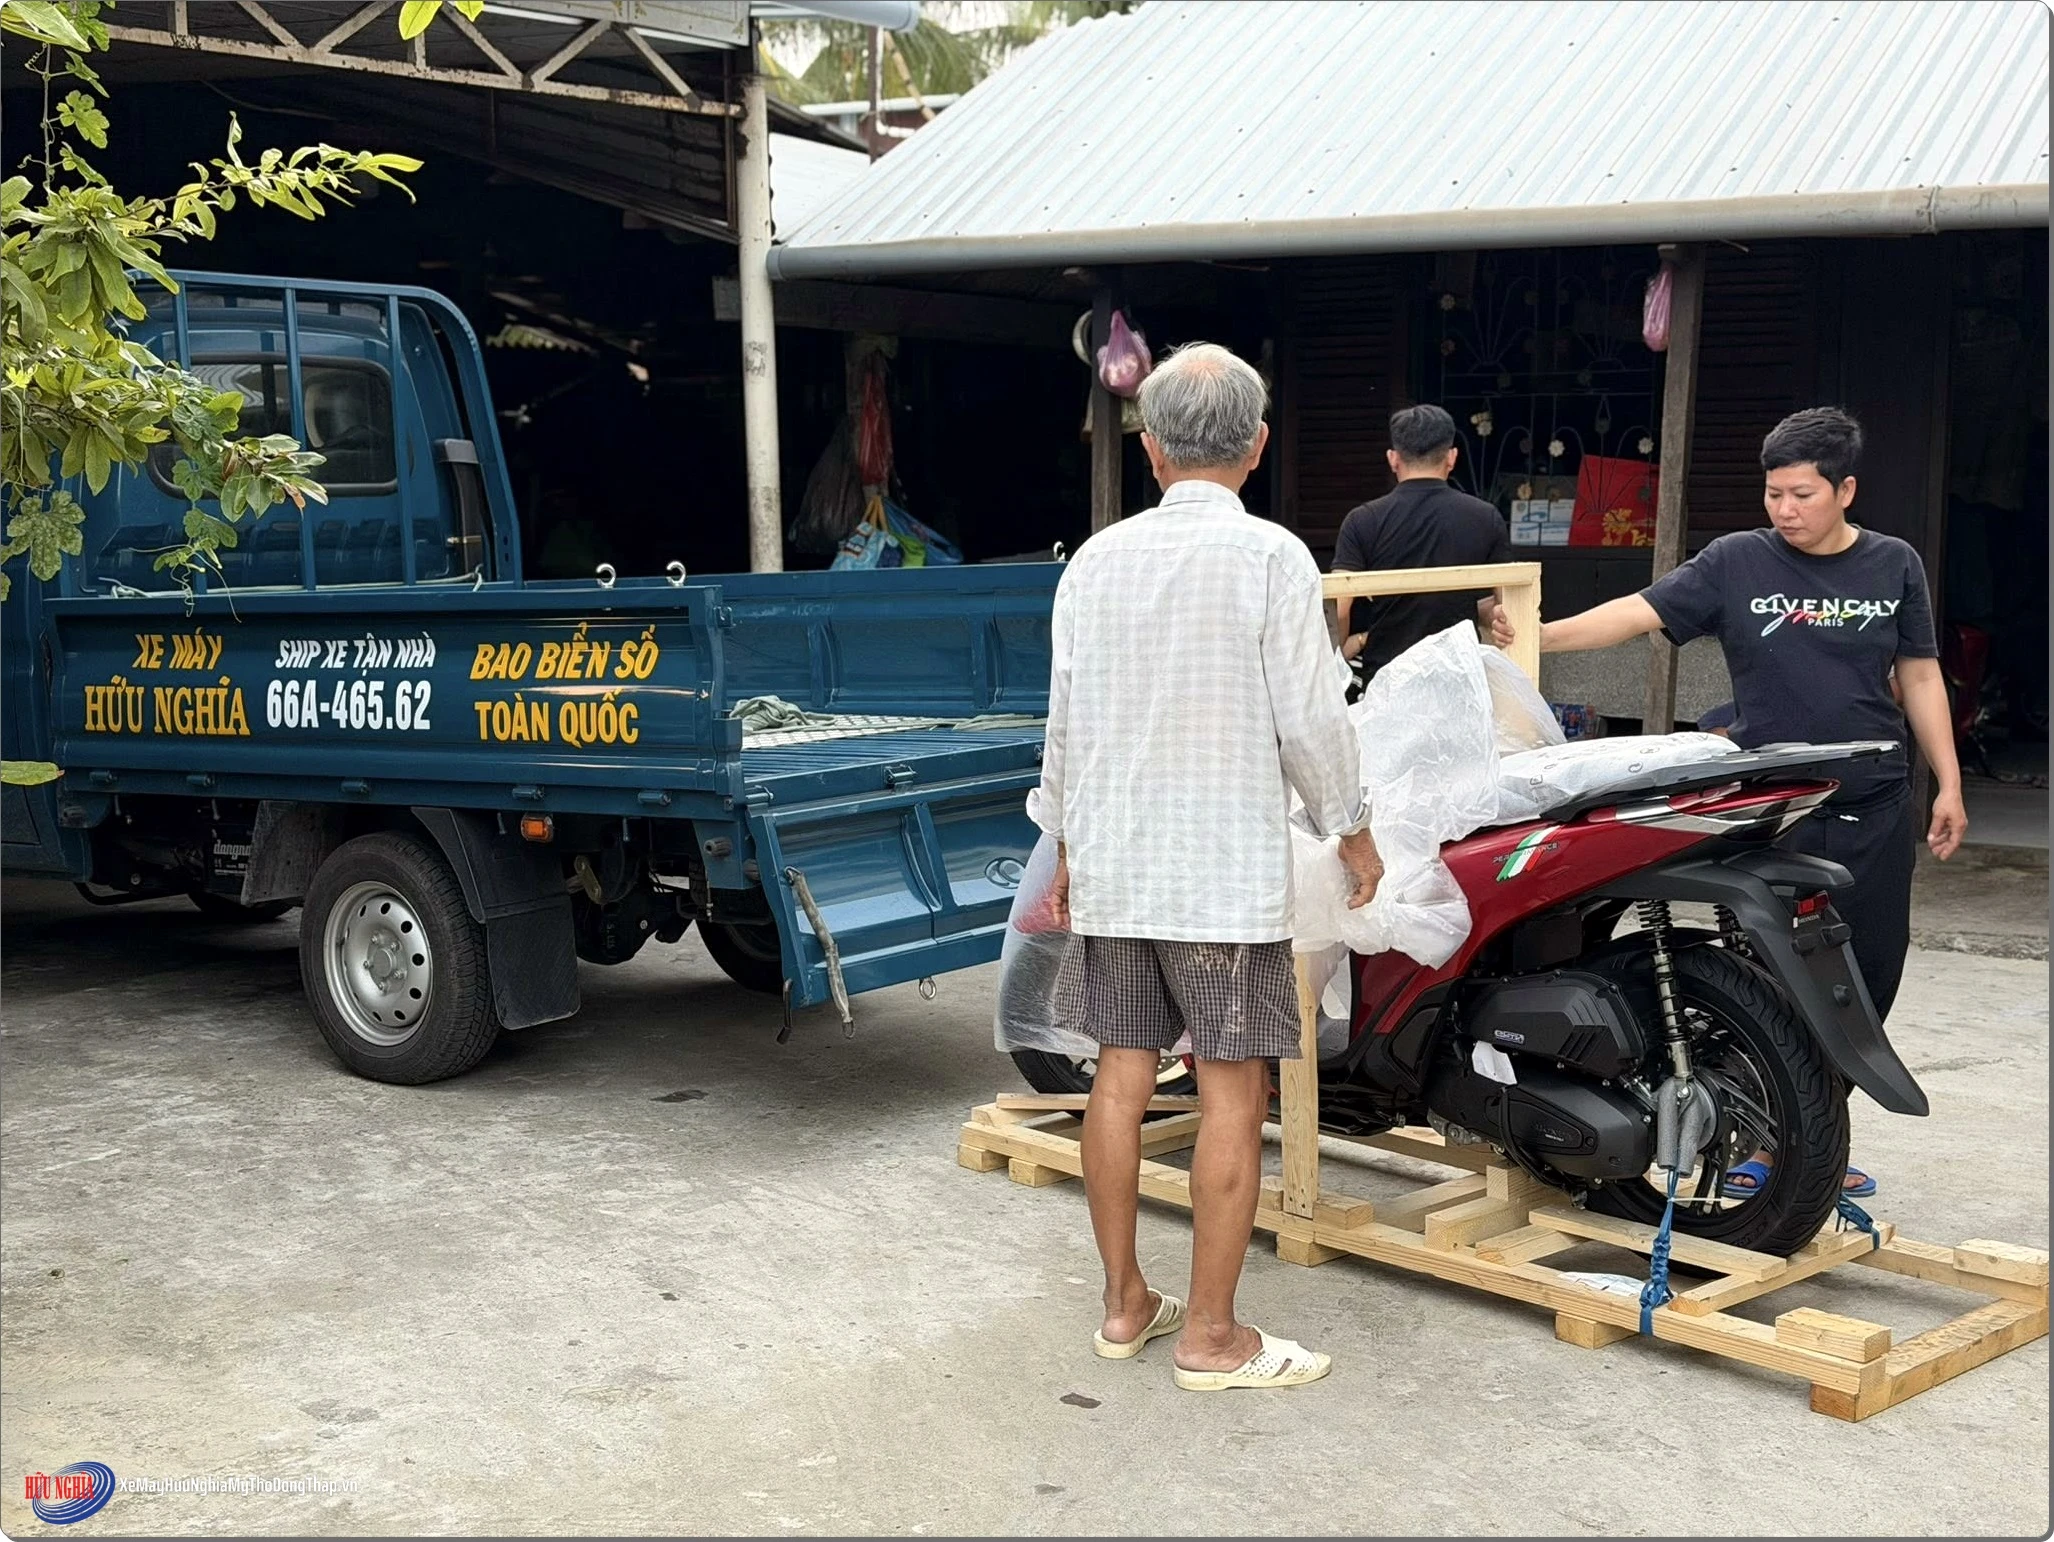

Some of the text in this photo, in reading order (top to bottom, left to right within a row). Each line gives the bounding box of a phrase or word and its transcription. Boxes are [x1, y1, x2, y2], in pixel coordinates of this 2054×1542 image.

[1750, 597, 1900, 617] GIVENCHY
[1807, 617, 1845, 628] PARIS
[132, 626, 223, 670] XE MÁY
[275, 631, 436, 677] SHIP XE TẬN NHÀ
[469, 621, 660, 680] BAO BIỂN SỐ
[84, 674, 251, 736] HỮU NGHĨA
[266, 679, 432, 731] 66A-465.62
[474, 686, 639, 749] TOÀN QUỐC
